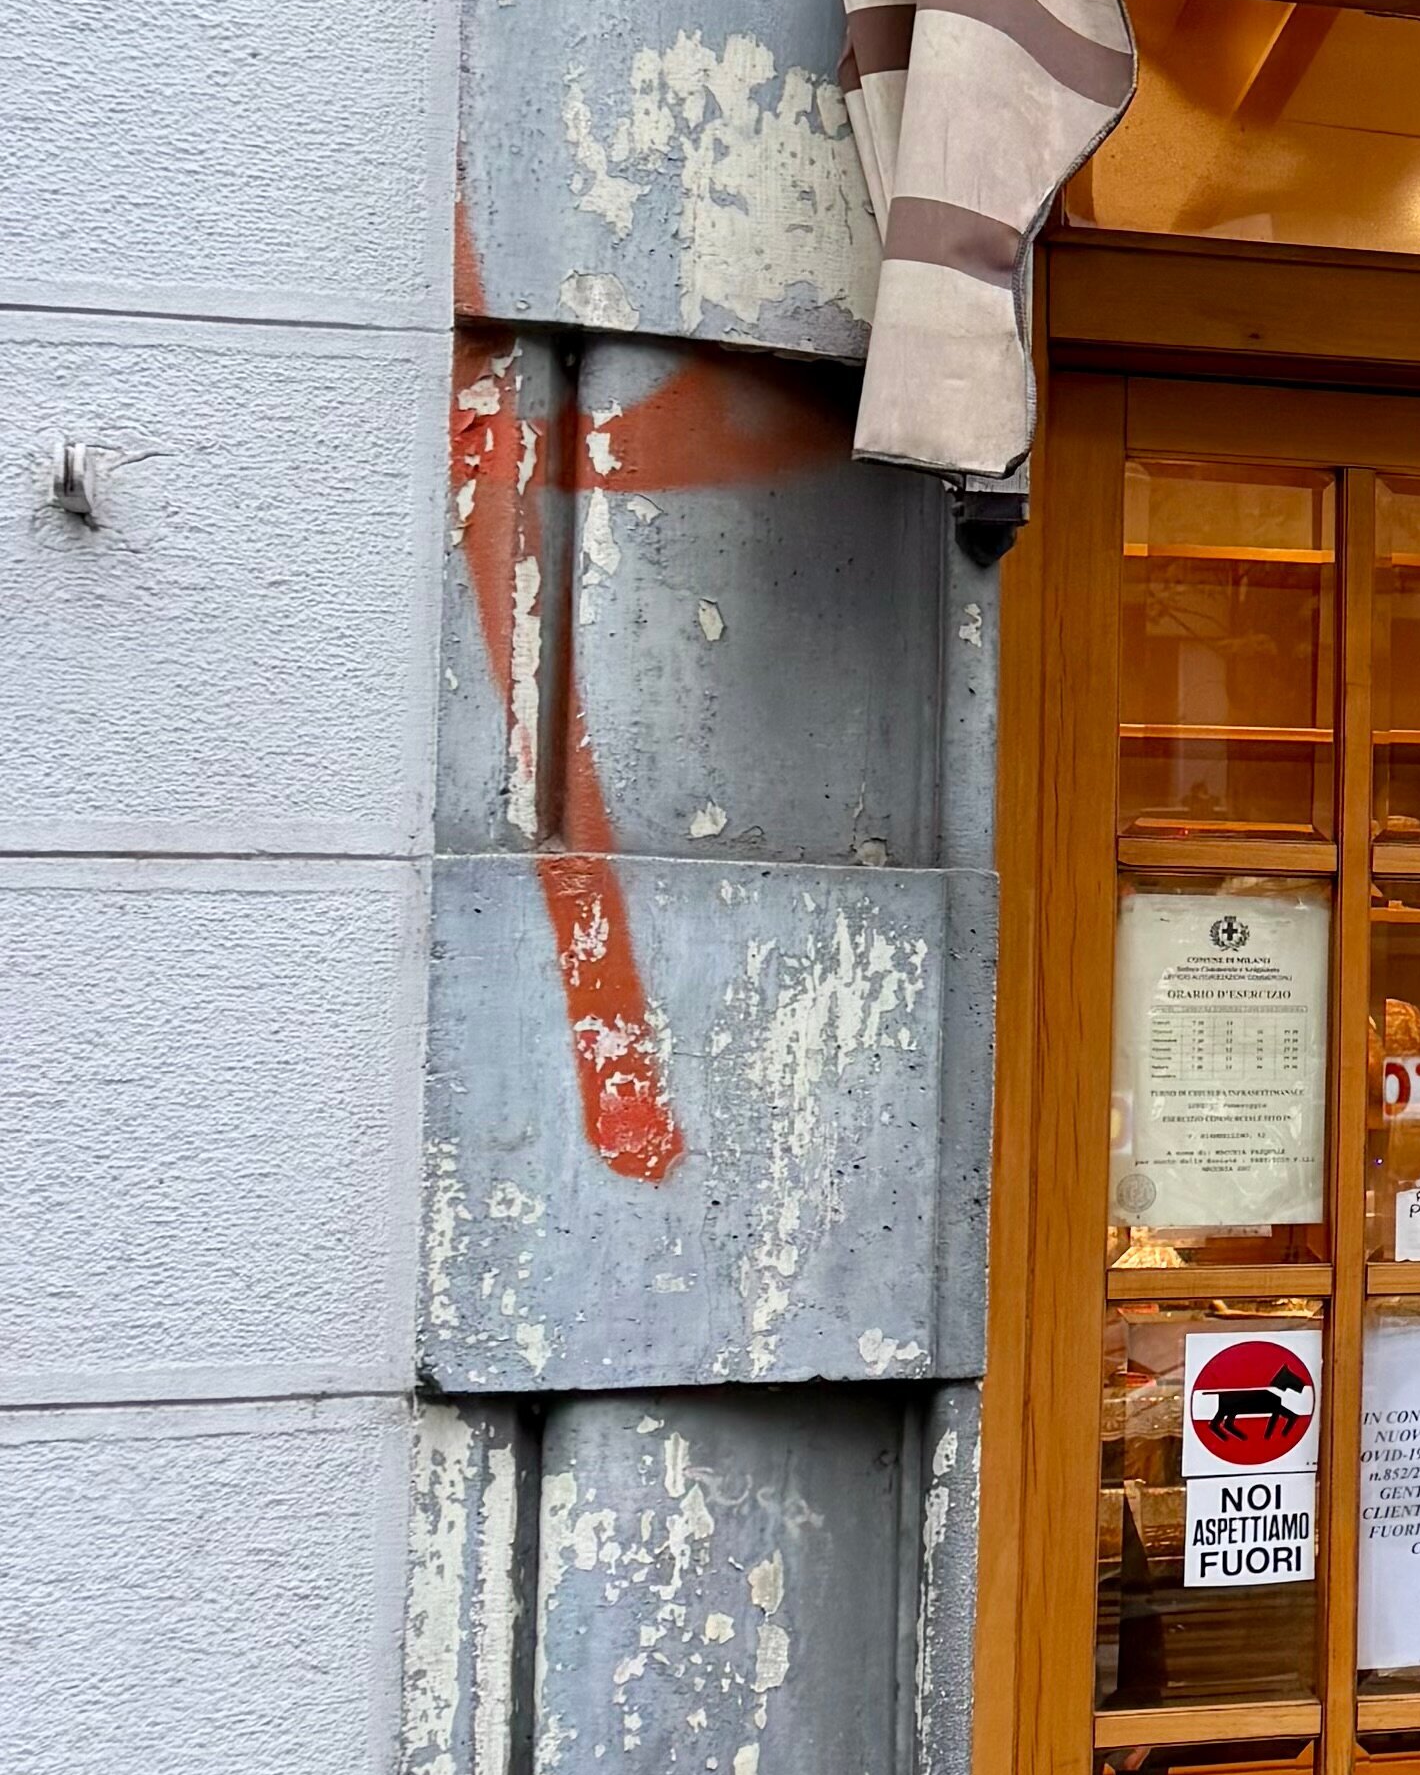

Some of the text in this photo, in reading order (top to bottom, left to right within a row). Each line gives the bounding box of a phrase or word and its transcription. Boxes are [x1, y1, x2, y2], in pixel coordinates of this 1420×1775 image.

[1363, 1412, 1383, 1426] IN
[1221, 1483, 1282, 1513] NOI
[1192, 1512, 1310, 1547] ASPETTIAMO
[1200, 1546, 1302, 1578] FUORI
